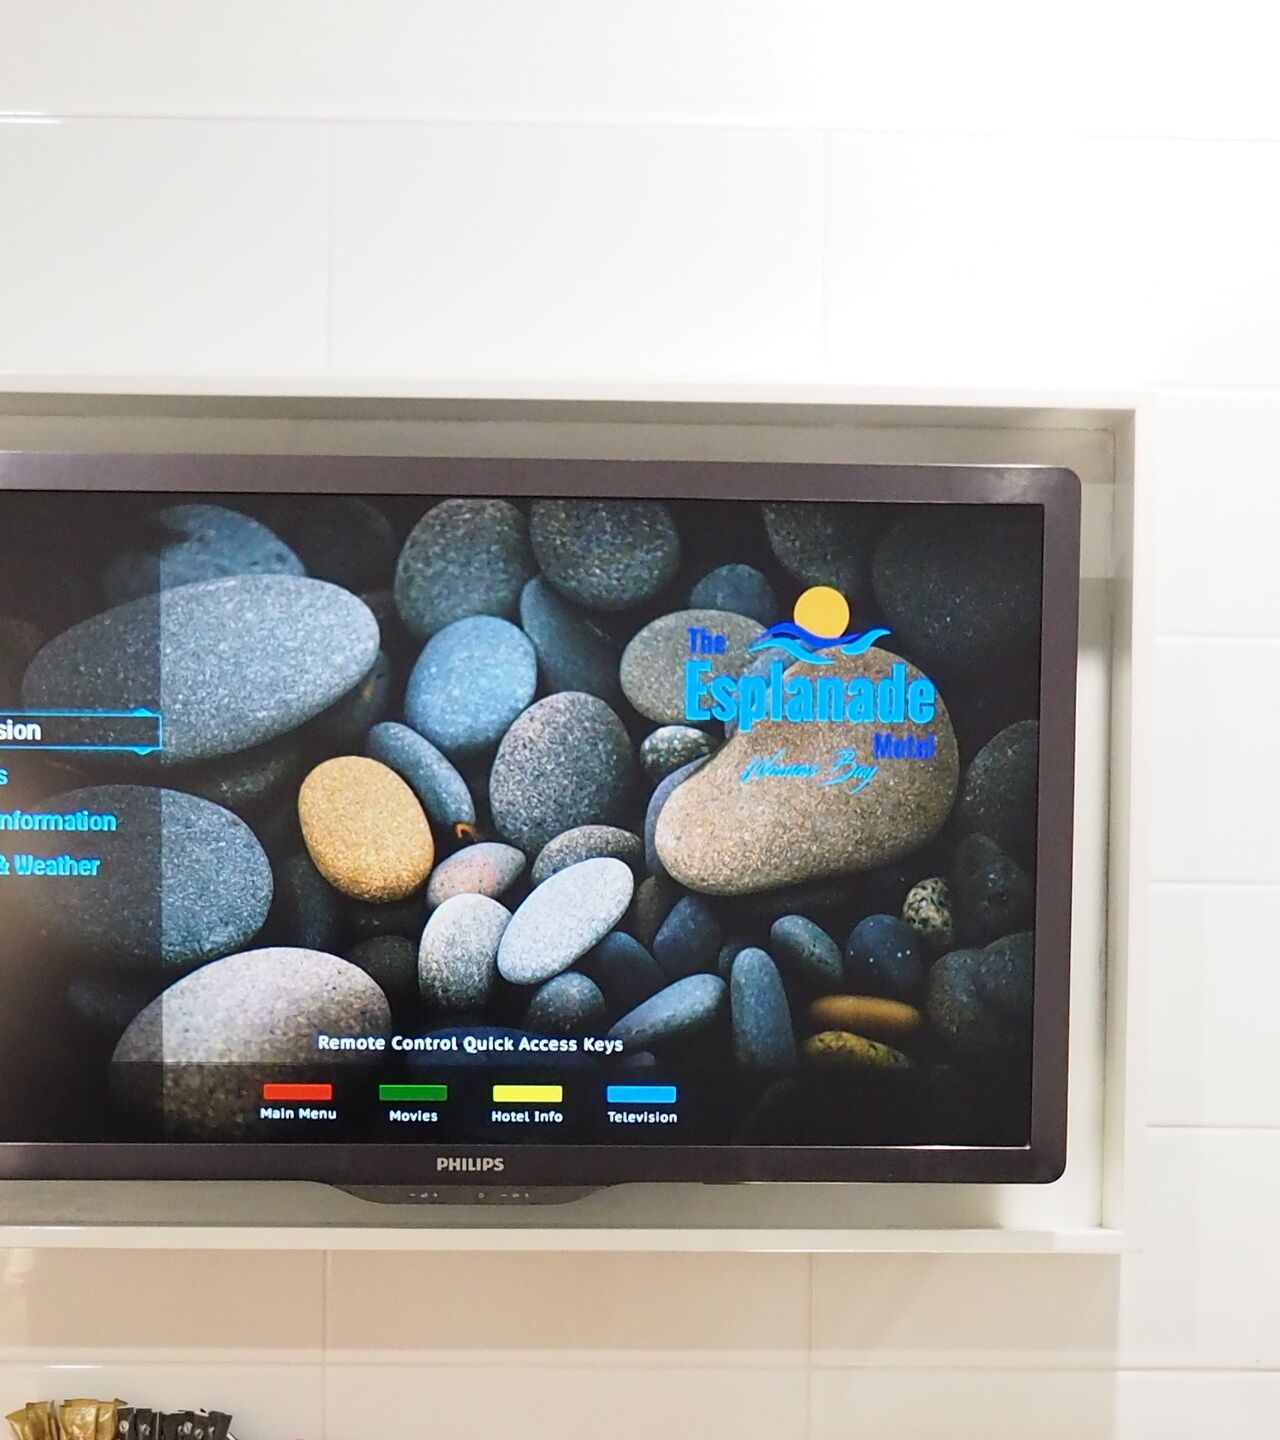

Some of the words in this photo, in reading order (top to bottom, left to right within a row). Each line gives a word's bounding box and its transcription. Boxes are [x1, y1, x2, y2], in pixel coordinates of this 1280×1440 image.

[687, 627, 727, 654] The
[684, 661, 937, 733] Esplanade
[872, 732, 937, 760] Motel
[815, 748, 880, 795] Bay
[13, 855, 101, 876] Weather
[318, 1035, 385, 1052] Remote
[391, 1035, 458, 1052] Control
[463, 1036, 514, 1054] Quick
[519, 1036, 577, 1052] Access
[583, 1037, 623, 1056] Keys
[260, 1107, 295, 1120] Main
[299, 1107, 337, 1120] Menu
[389, 1110, 438, 1123] Movies
[492, 1110, 530, 1123] Hotel
[534, 1110, 563, 1123] Info
[607, 1111, 677, 1124] Television
[436, 1157, 504, 1172] PHILIPS
